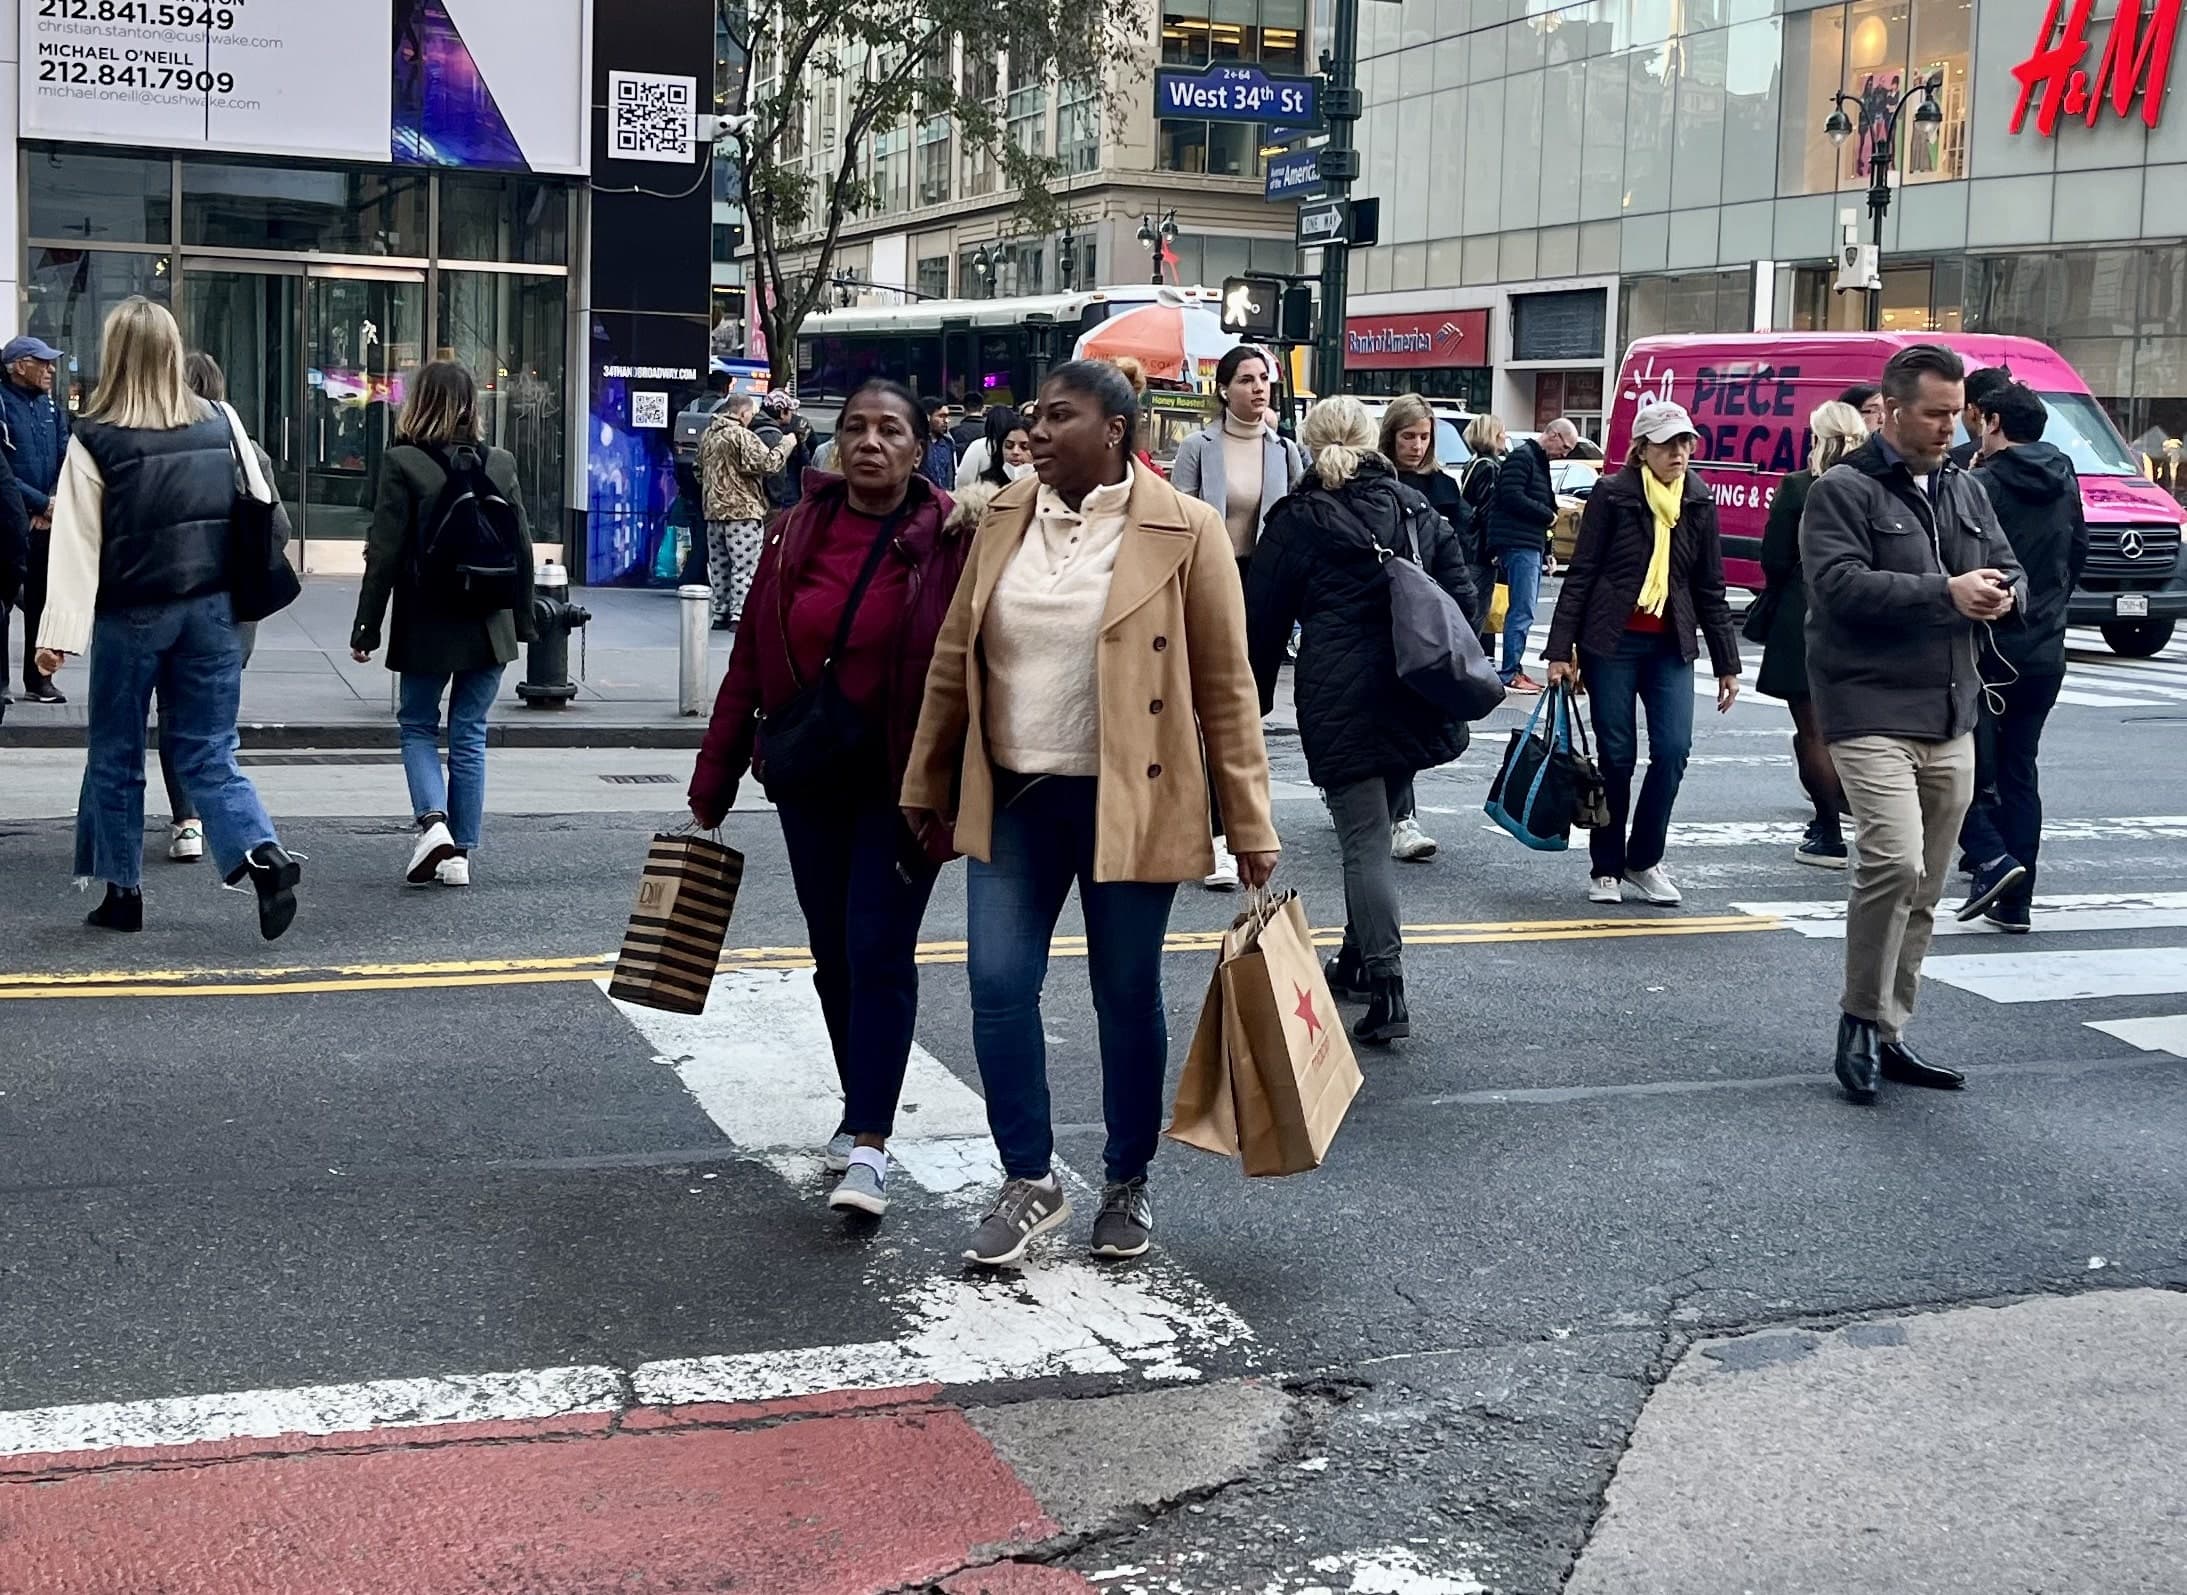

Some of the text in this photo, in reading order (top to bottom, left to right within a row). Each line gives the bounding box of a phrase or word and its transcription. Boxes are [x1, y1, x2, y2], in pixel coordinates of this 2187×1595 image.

[38, 0, 235, 30] 212.841.5949
[38, 43, 194, 66] MICHAEL O'NEILL
[2009, 0, 2184, 137] H&M
[38, 60, 235, 94] 212.841.7909
[38, 85, 261, 111] michael.oneill@cushwake.com
[1169, 81, 1304, 113] West 34th St
[1305, 213, 1338, 233] ONE WAY
[1348, 330, 1375, 354] Bank
[1386, 327, 1432, 352] America
[1692, 364, 1801, 417] PIECE
[1748, 485, 1760, 508] &
